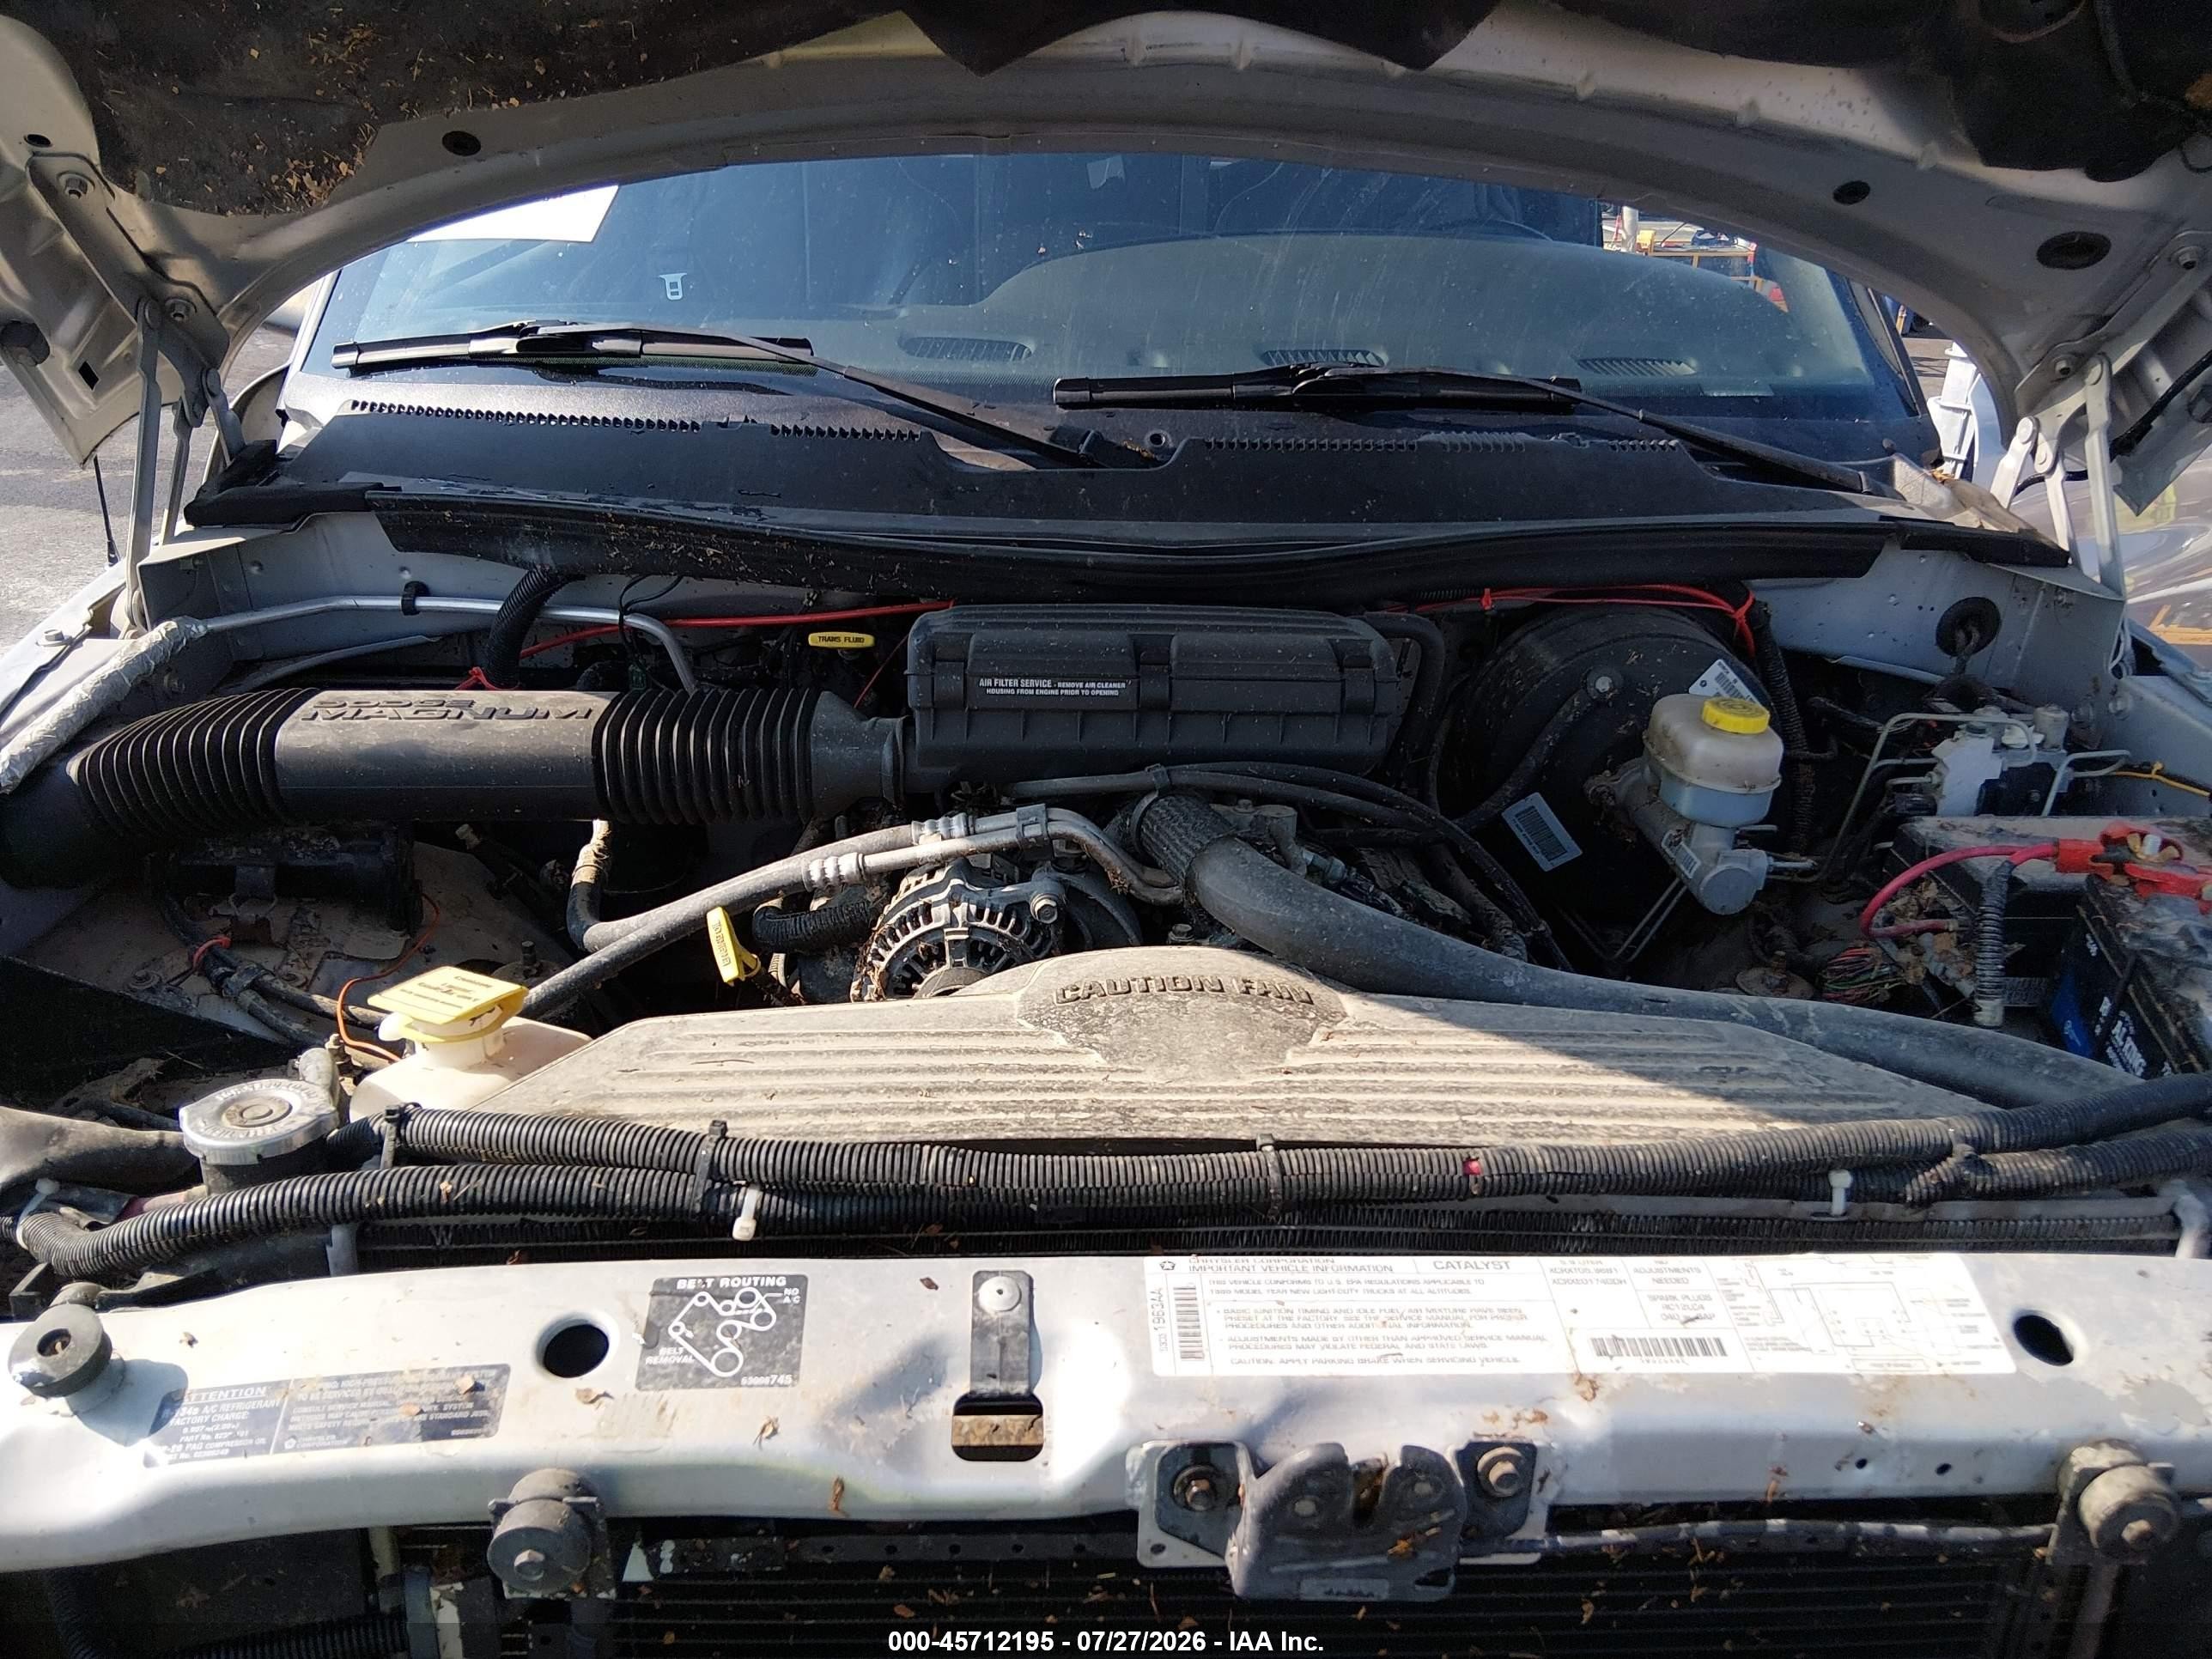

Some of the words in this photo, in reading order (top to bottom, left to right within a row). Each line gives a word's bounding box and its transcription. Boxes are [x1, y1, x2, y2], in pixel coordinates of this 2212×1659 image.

[979, 678, 992, 687] AIR
[994, 678, 1018, 687] FILTER
[1020, 678, 1052, 688] SERVICE
[313, 699, 476, 708] DODGE
[301, 707, 593, 721] MAGNUM
[1054, 975, 1225, 1006] CAUTION
[1235, 977, 1315, 1006] FAN
[1432, 1260, 1511, 1271] CATALYST
[720, 1276, 787, 1288] ROUTING
[659, 1347, 684, 1356] BELT
[645, 1355, 696, 1365] REMOVAL
[218, 1400, 281, 1413] REFRIGERANT
[170, 1415, 210, 1426] FACTORY
